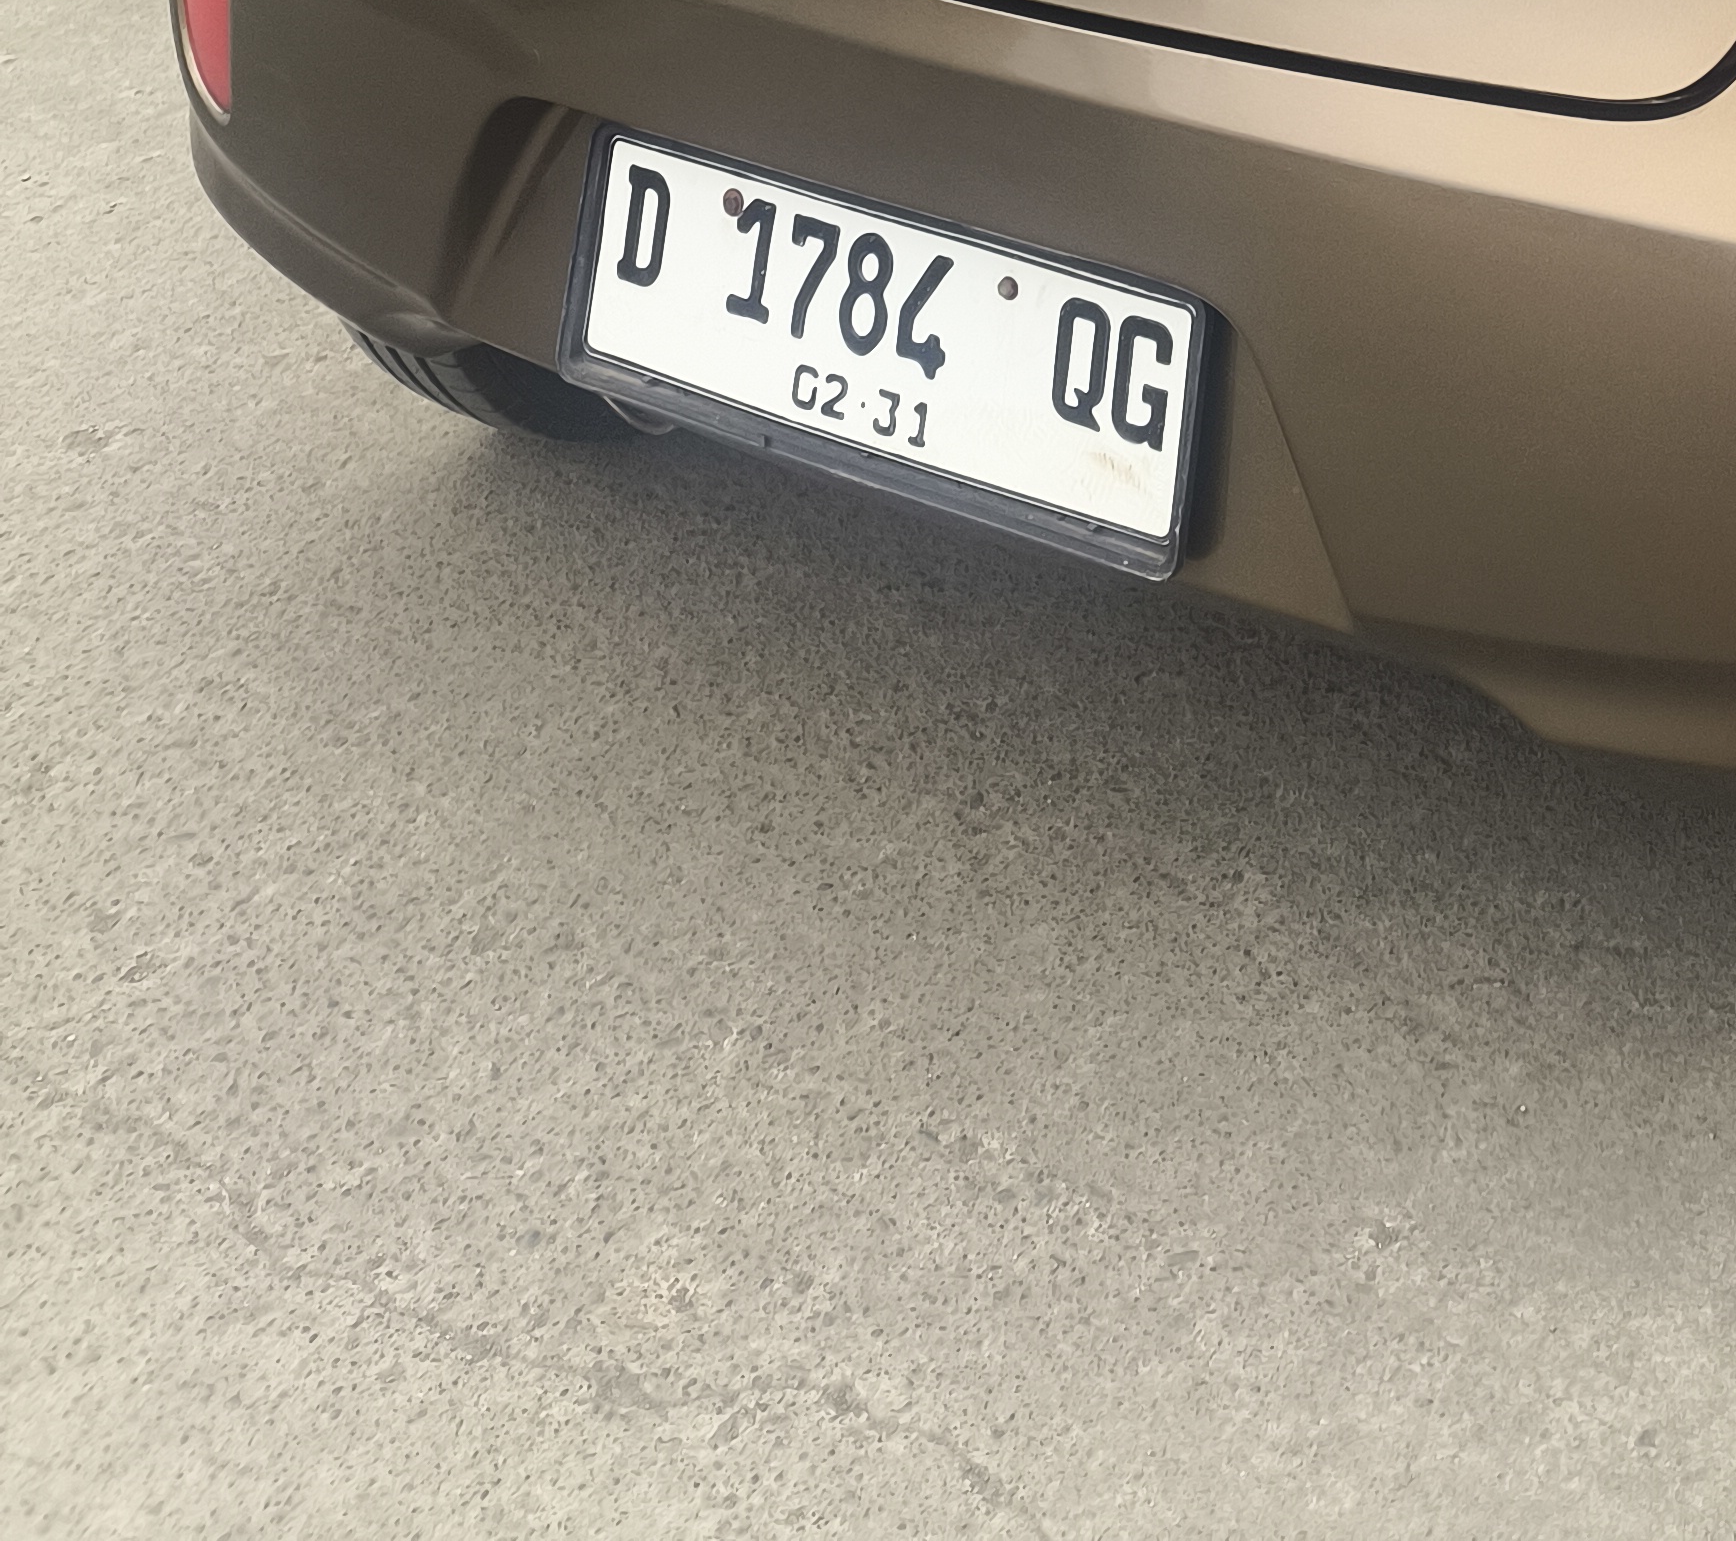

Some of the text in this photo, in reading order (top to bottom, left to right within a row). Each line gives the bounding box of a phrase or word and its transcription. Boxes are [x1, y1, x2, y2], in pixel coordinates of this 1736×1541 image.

[616, 164, 1174, 453] D 1784 QG
